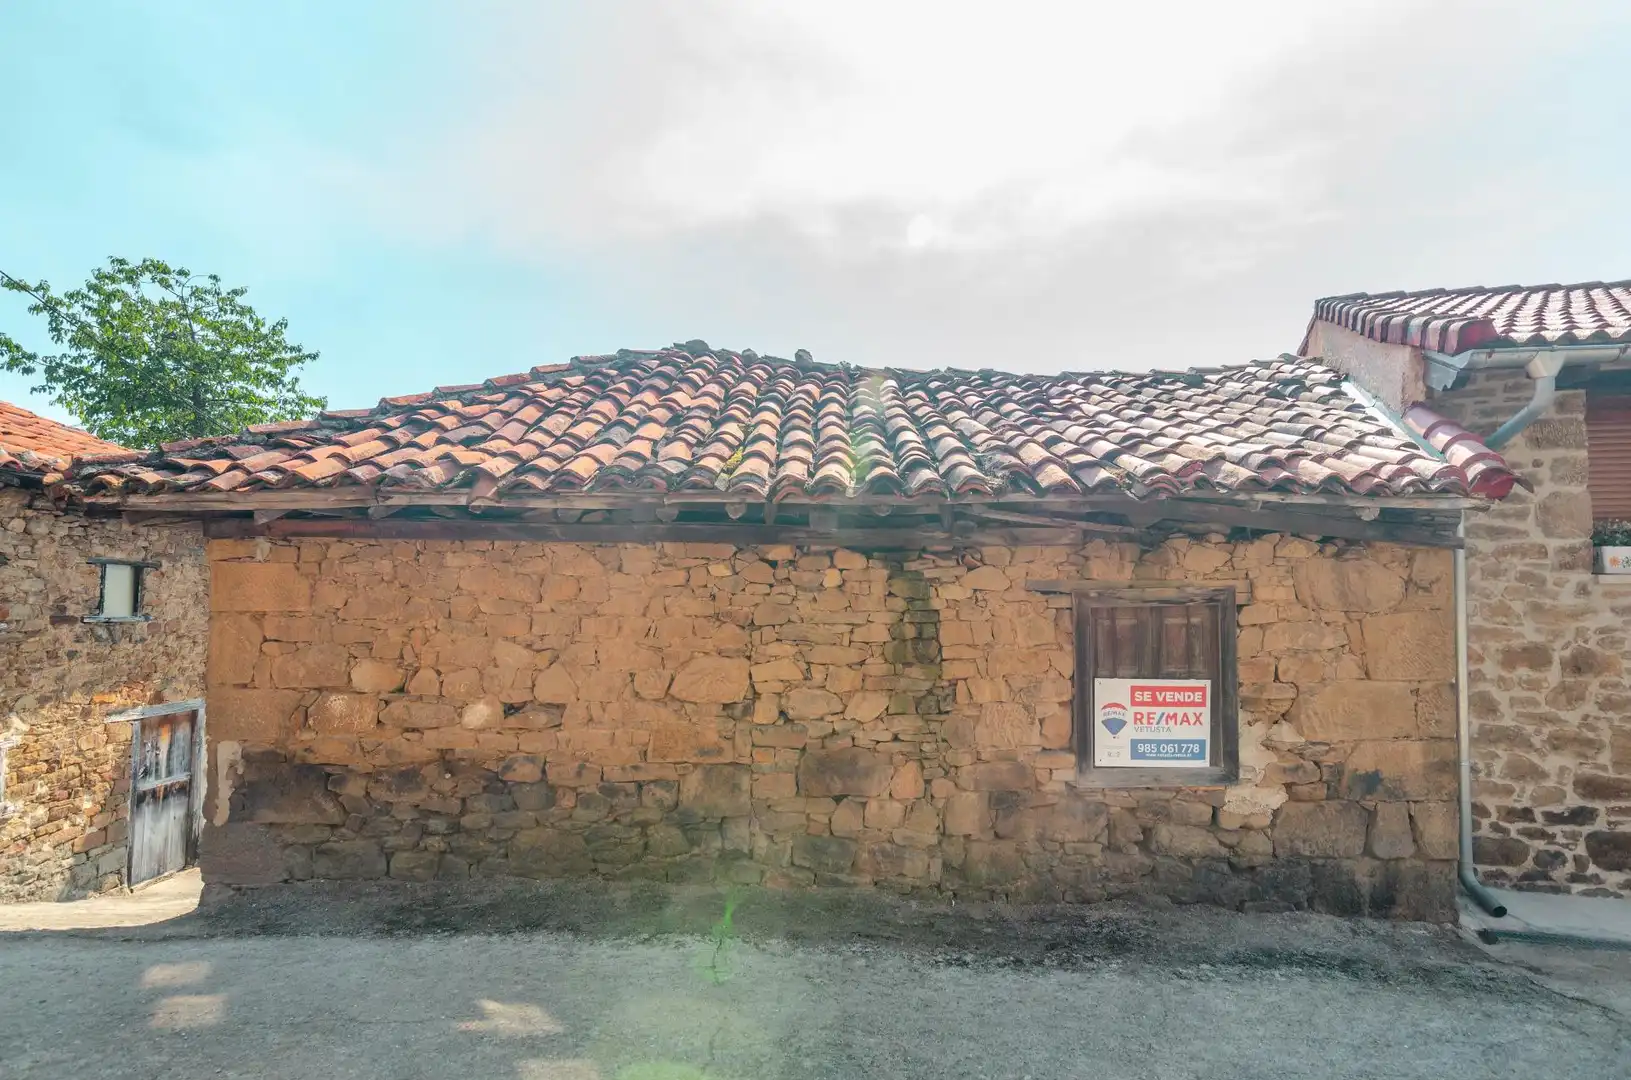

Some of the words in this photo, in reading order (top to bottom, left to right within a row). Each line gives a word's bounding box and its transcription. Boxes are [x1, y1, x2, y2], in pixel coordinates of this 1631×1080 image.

[1134, 691, 1152, 702] SE
[1155, 691, 1202, 702] VENDE
[1133, 712, 1203, 726] RE/MAX
[1137, 743, 1157, 753] 985
[1160, 743, 1178, 753] 061
[1181, 743, 1200, 753] 778
